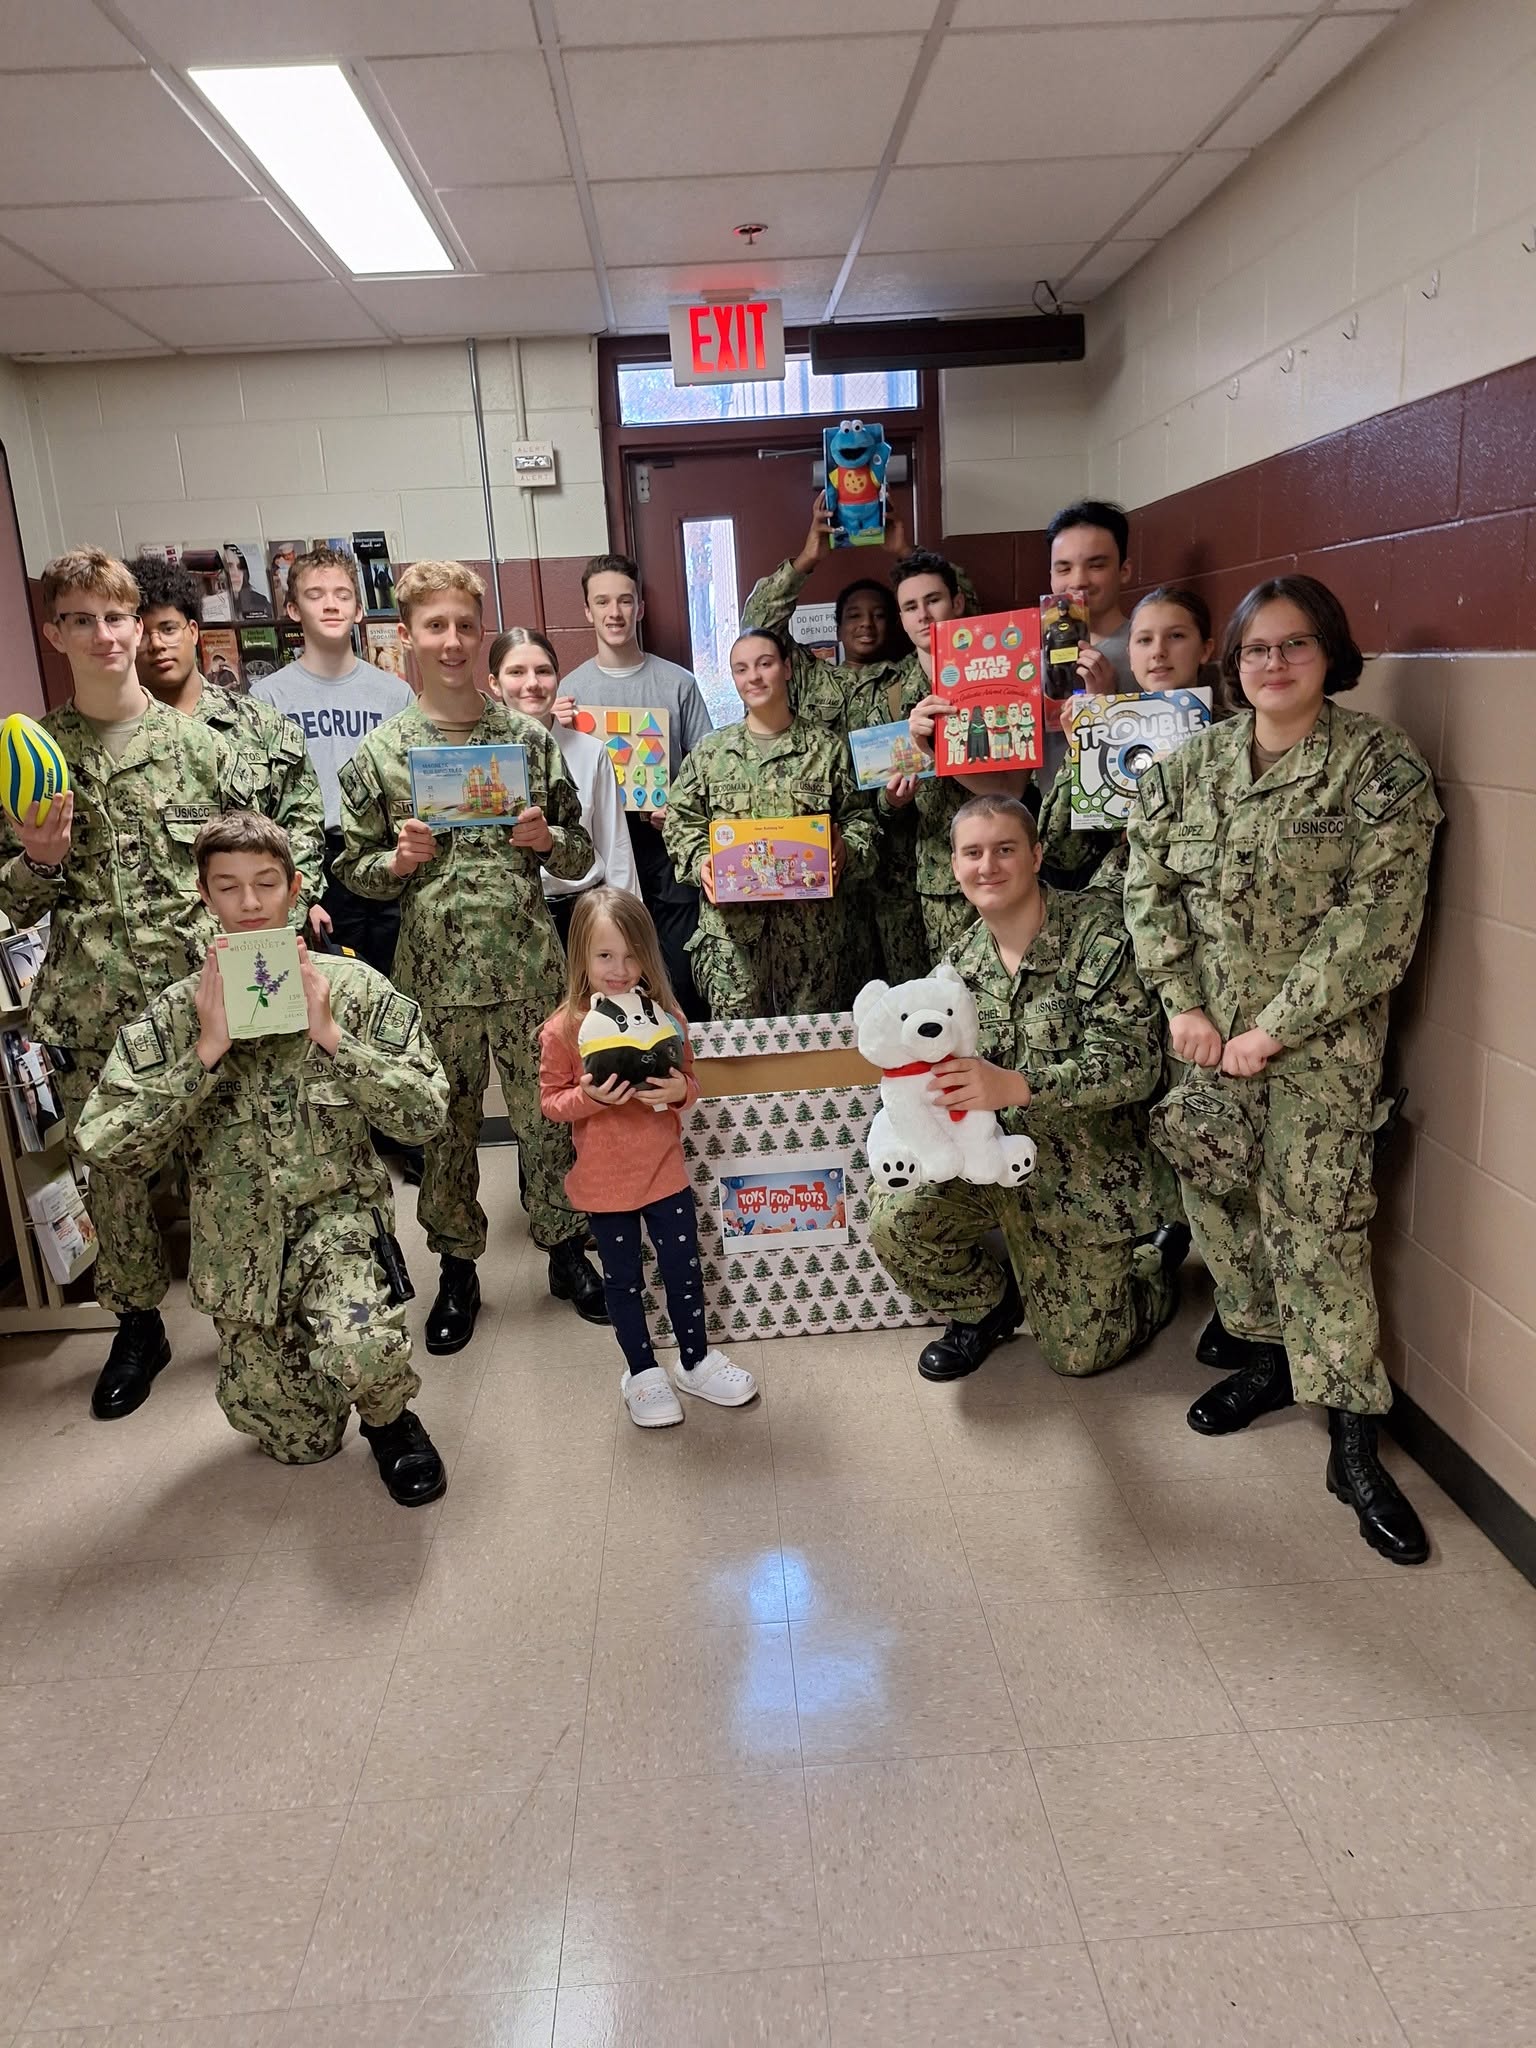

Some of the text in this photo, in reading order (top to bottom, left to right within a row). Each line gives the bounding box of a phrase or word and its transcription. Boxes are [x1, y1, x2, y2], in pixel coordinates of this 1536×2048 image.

[689, 303, 769, 374] EXIT
[796, 613, 836, 624] DO NOT PR
[800, 625, 838, 636] OPEN DOO
[969, 655, 1011, 670] STAR
[964, 665, 1009, 682] WARS
[1075, 708, 1204, 750] TROUBLE
[244, 752, 261, 761] TOS
[631, 765, 647, 786] 4
[653, 766, 667, 786] 5
[44, 768, 54, 801] Franklin
[713, 781, 746, 793] GOODMAN
[632, 787, 647, 808] 9
[174, 807, 210, 818] USNSCC
[1178, 824, 1204, 837] LOPEZ
[1292, 820, 1344, 836] USNSCC
[234, 940, 280, 952] BOUQUET
[1035, 997, 1075, 1014] USNSCC
[977, 1009, 1000, 1020] CHEL
[739, 1189, 824, 1205] TOYS FOR TOTS
